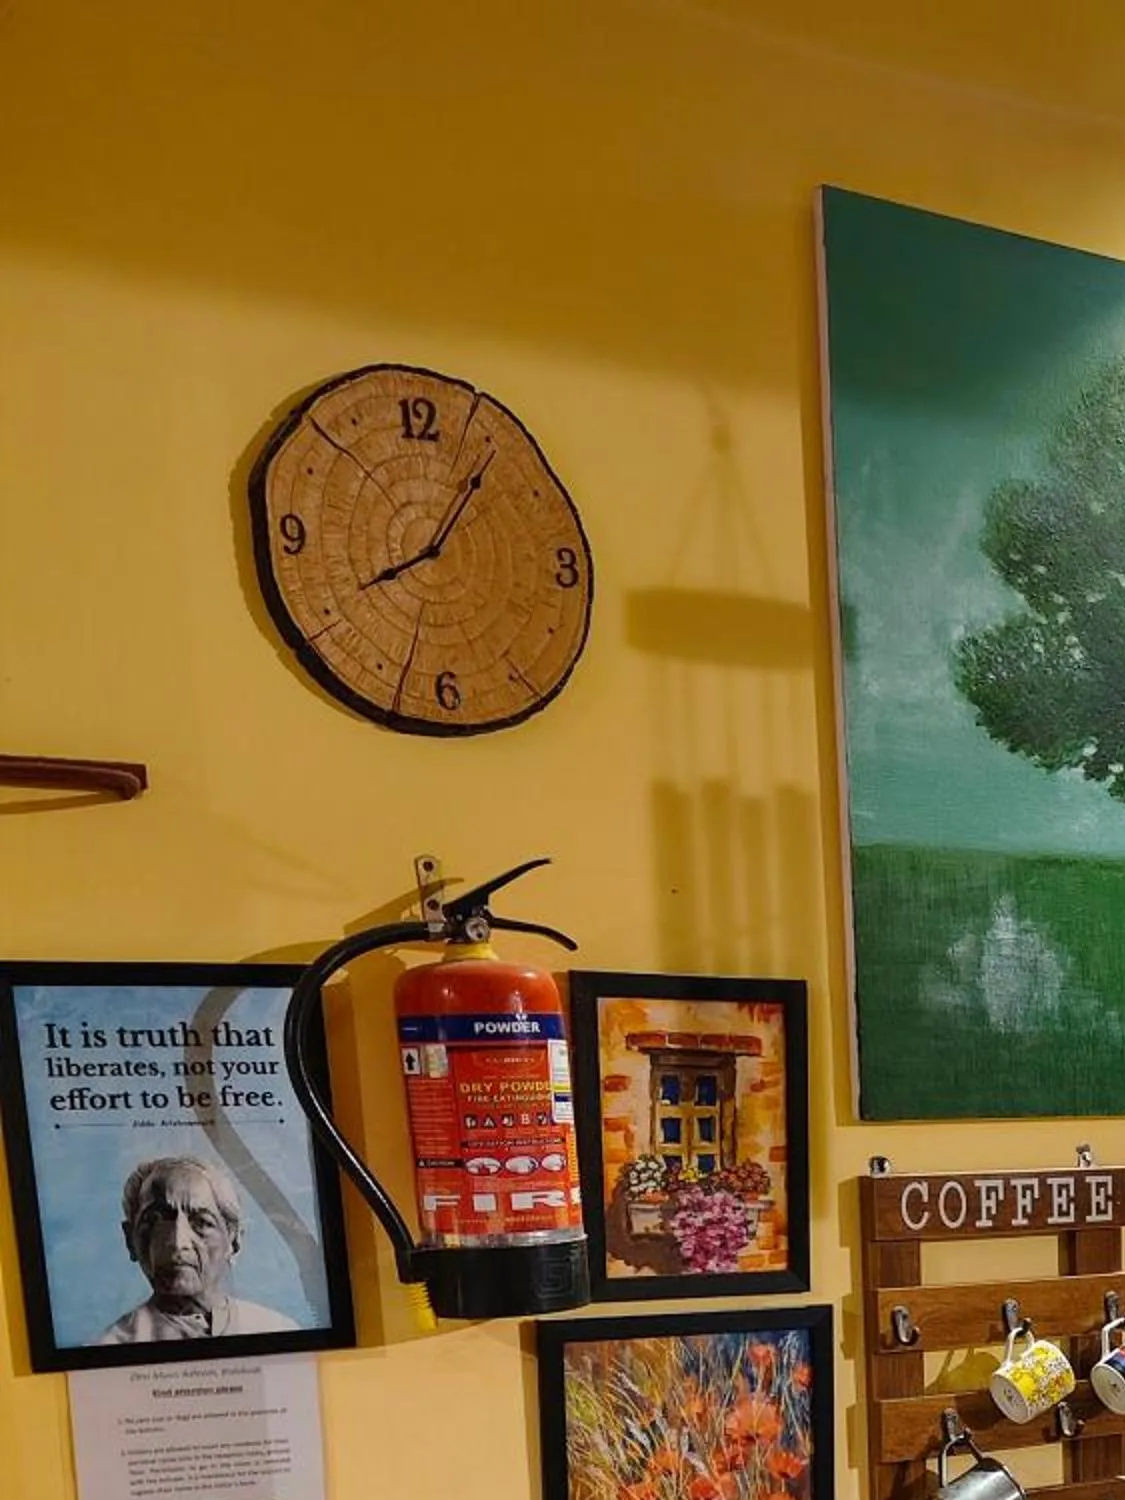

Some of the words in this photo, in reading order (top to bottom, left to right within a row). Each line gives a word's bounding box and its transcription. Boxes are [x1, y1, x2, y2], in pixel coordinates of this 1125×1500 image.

[400, 397, 440, 442] 12
[279, 513, 306, 555] 9
[556, 547, 579, 589] 3
[435, 671, 462, 712] 6
[44, 1022, 70, 1049] It
[81, 1021, 107, 1048] is
[116, 1021, 200, 1048] truth
[211, 1021, 276, 1047] that
[473, 1021, 541, 1035] POWDER
[44, 1056, 166, 1079] liberates,
[173, 1059, 216, 1076] not
[222, 1060, 280, 1080] your
[50, 1086, 133, 1111] effort
[140, 1090, 169, 1109] to
[175, 1085, 211, 1109] be
[219, 1085, 283, 1107] free.
[460, 1081, 493, 1094] DRY
[500, 1080, 552, 1092] POWD
[901, 1175, 1114, 1231] COFFEE
